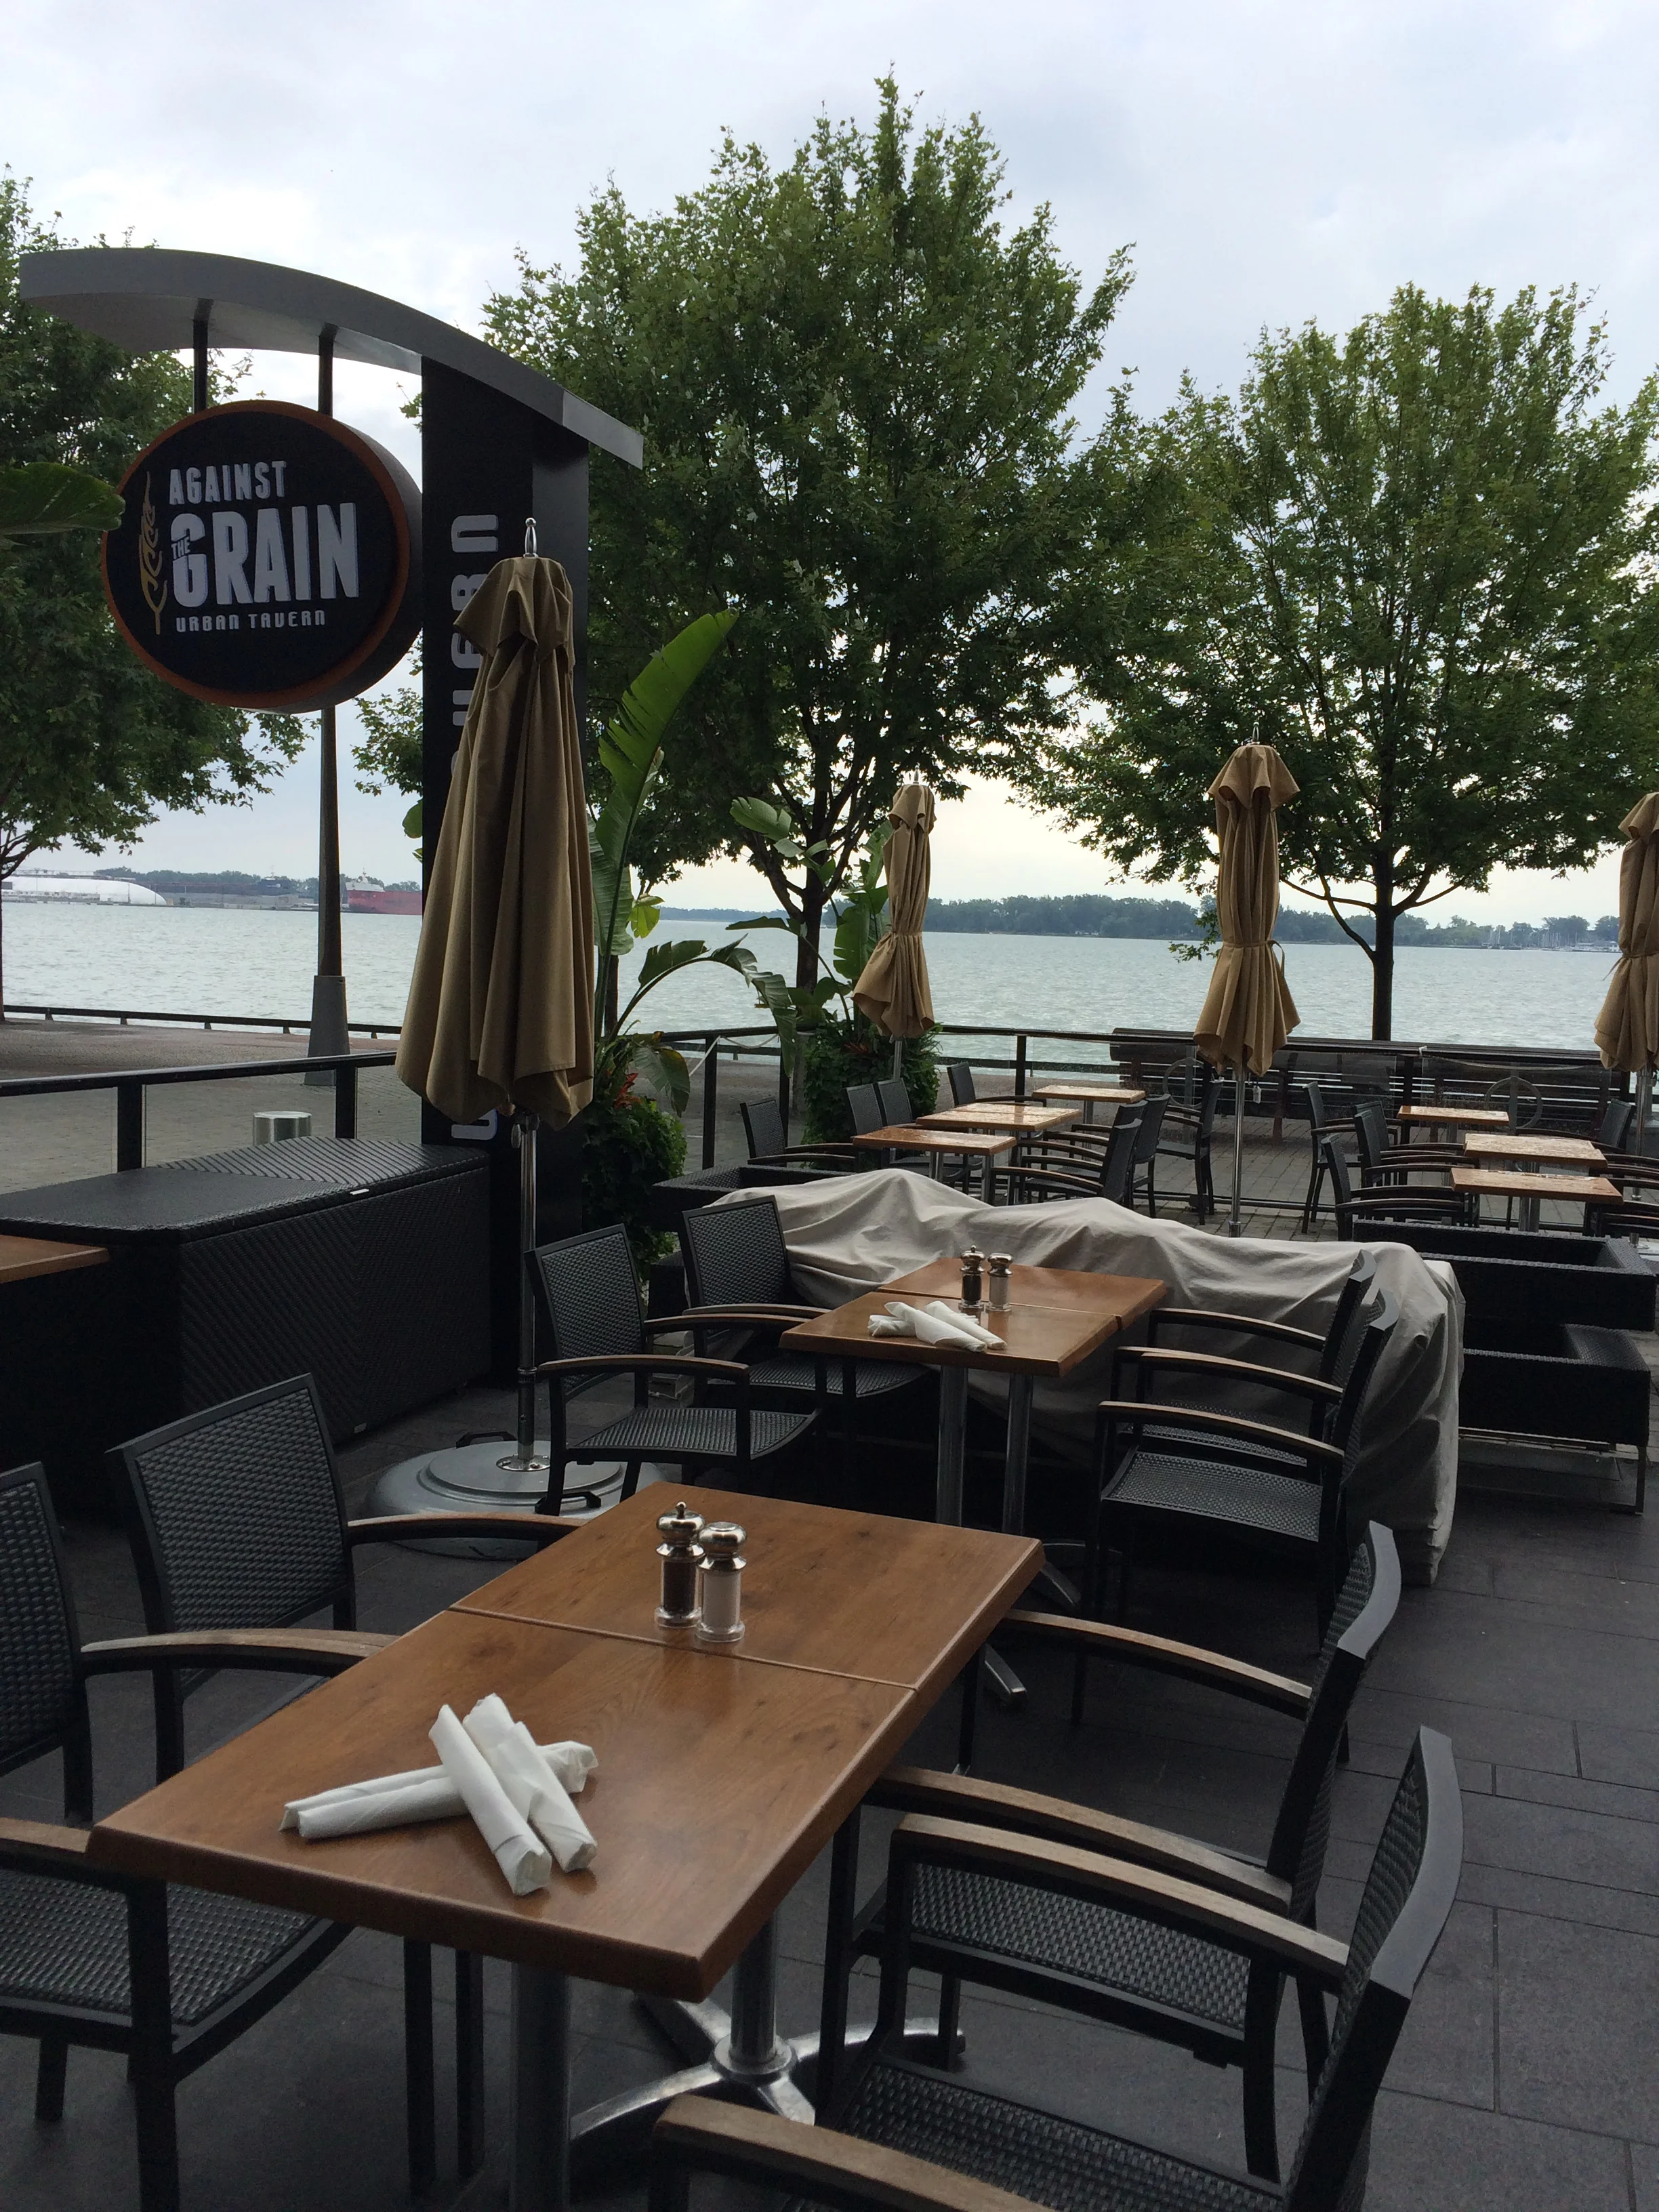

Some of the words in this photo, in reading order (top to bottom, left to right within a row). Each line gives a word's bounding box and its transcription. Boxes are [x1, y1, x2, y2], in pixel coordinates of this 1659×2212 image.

[169, 460, 287, 505] AGAINST
[171, 536, 190, 560] THE
[171, 502, 359, 608] GRAIN
[176, 614, 239, 632] URBAN
[248, 610, 325, 629] TAVERN
